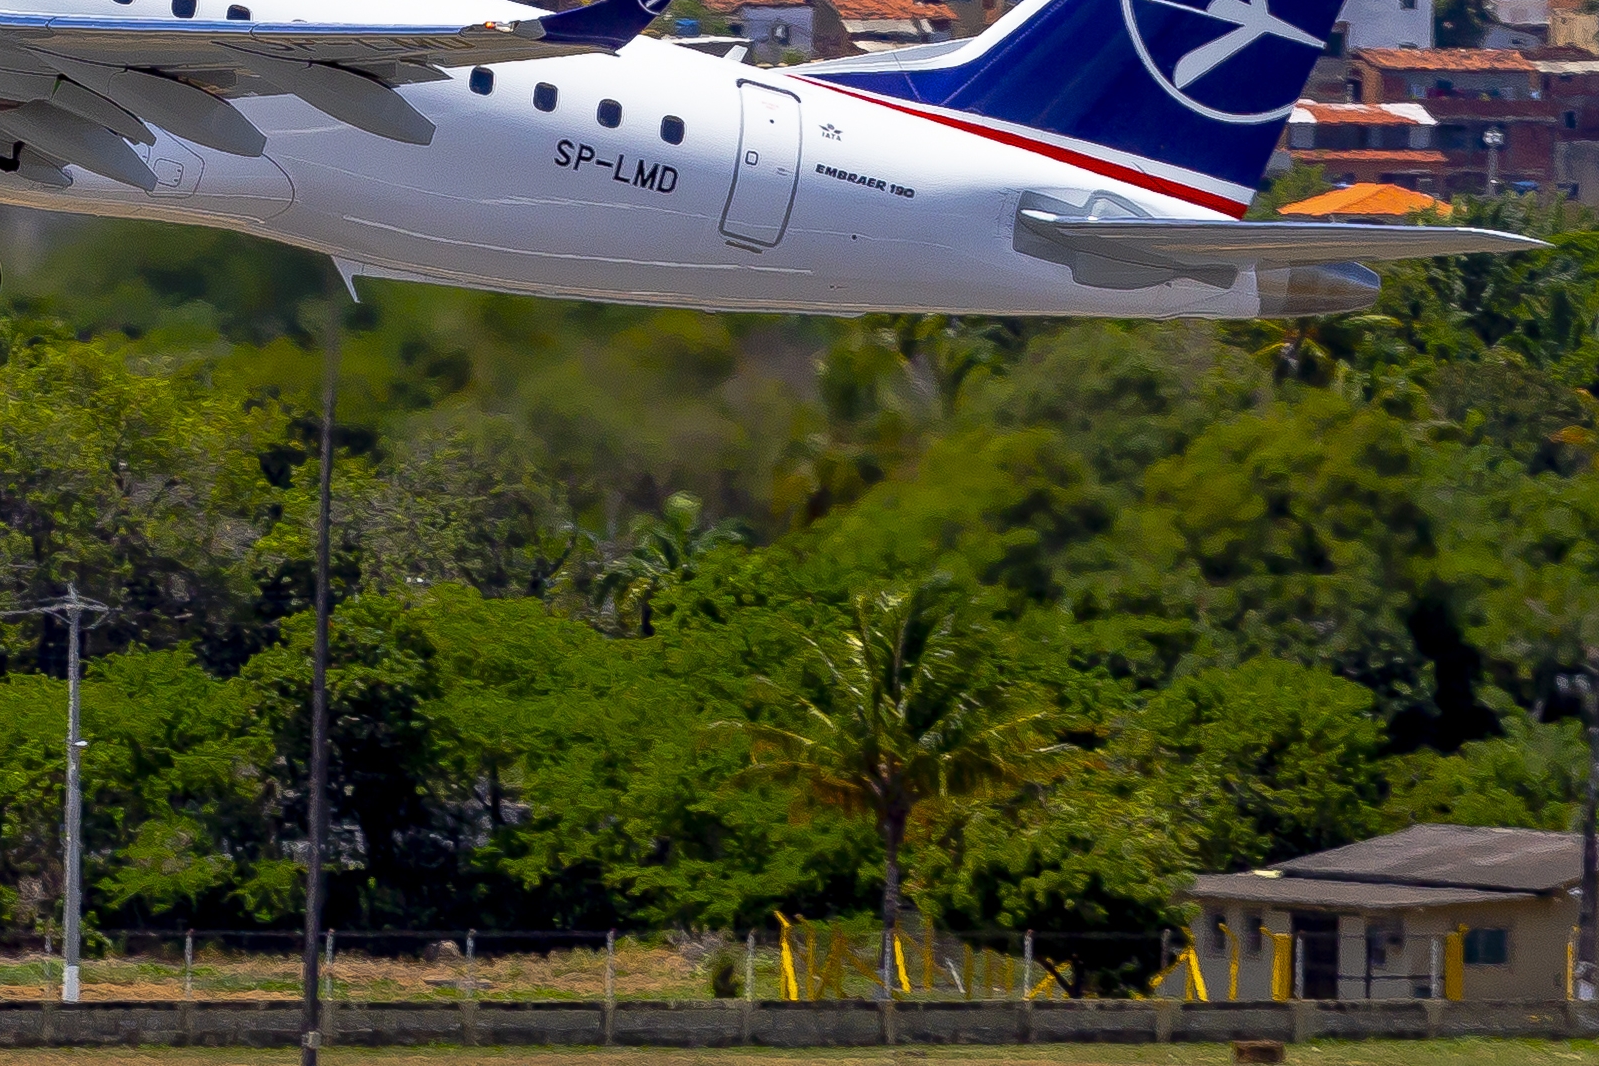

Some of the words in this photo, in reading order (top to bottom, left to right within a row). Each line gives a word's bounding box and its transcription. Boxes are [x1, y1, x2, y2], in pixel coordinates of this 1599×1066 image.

[822, 131, 842, 142] IATA
[554, 139, 679, 194] SP-LMD
[815, 163, 887, 192] EMBRAER
[889, 183, 915, 199] 190
